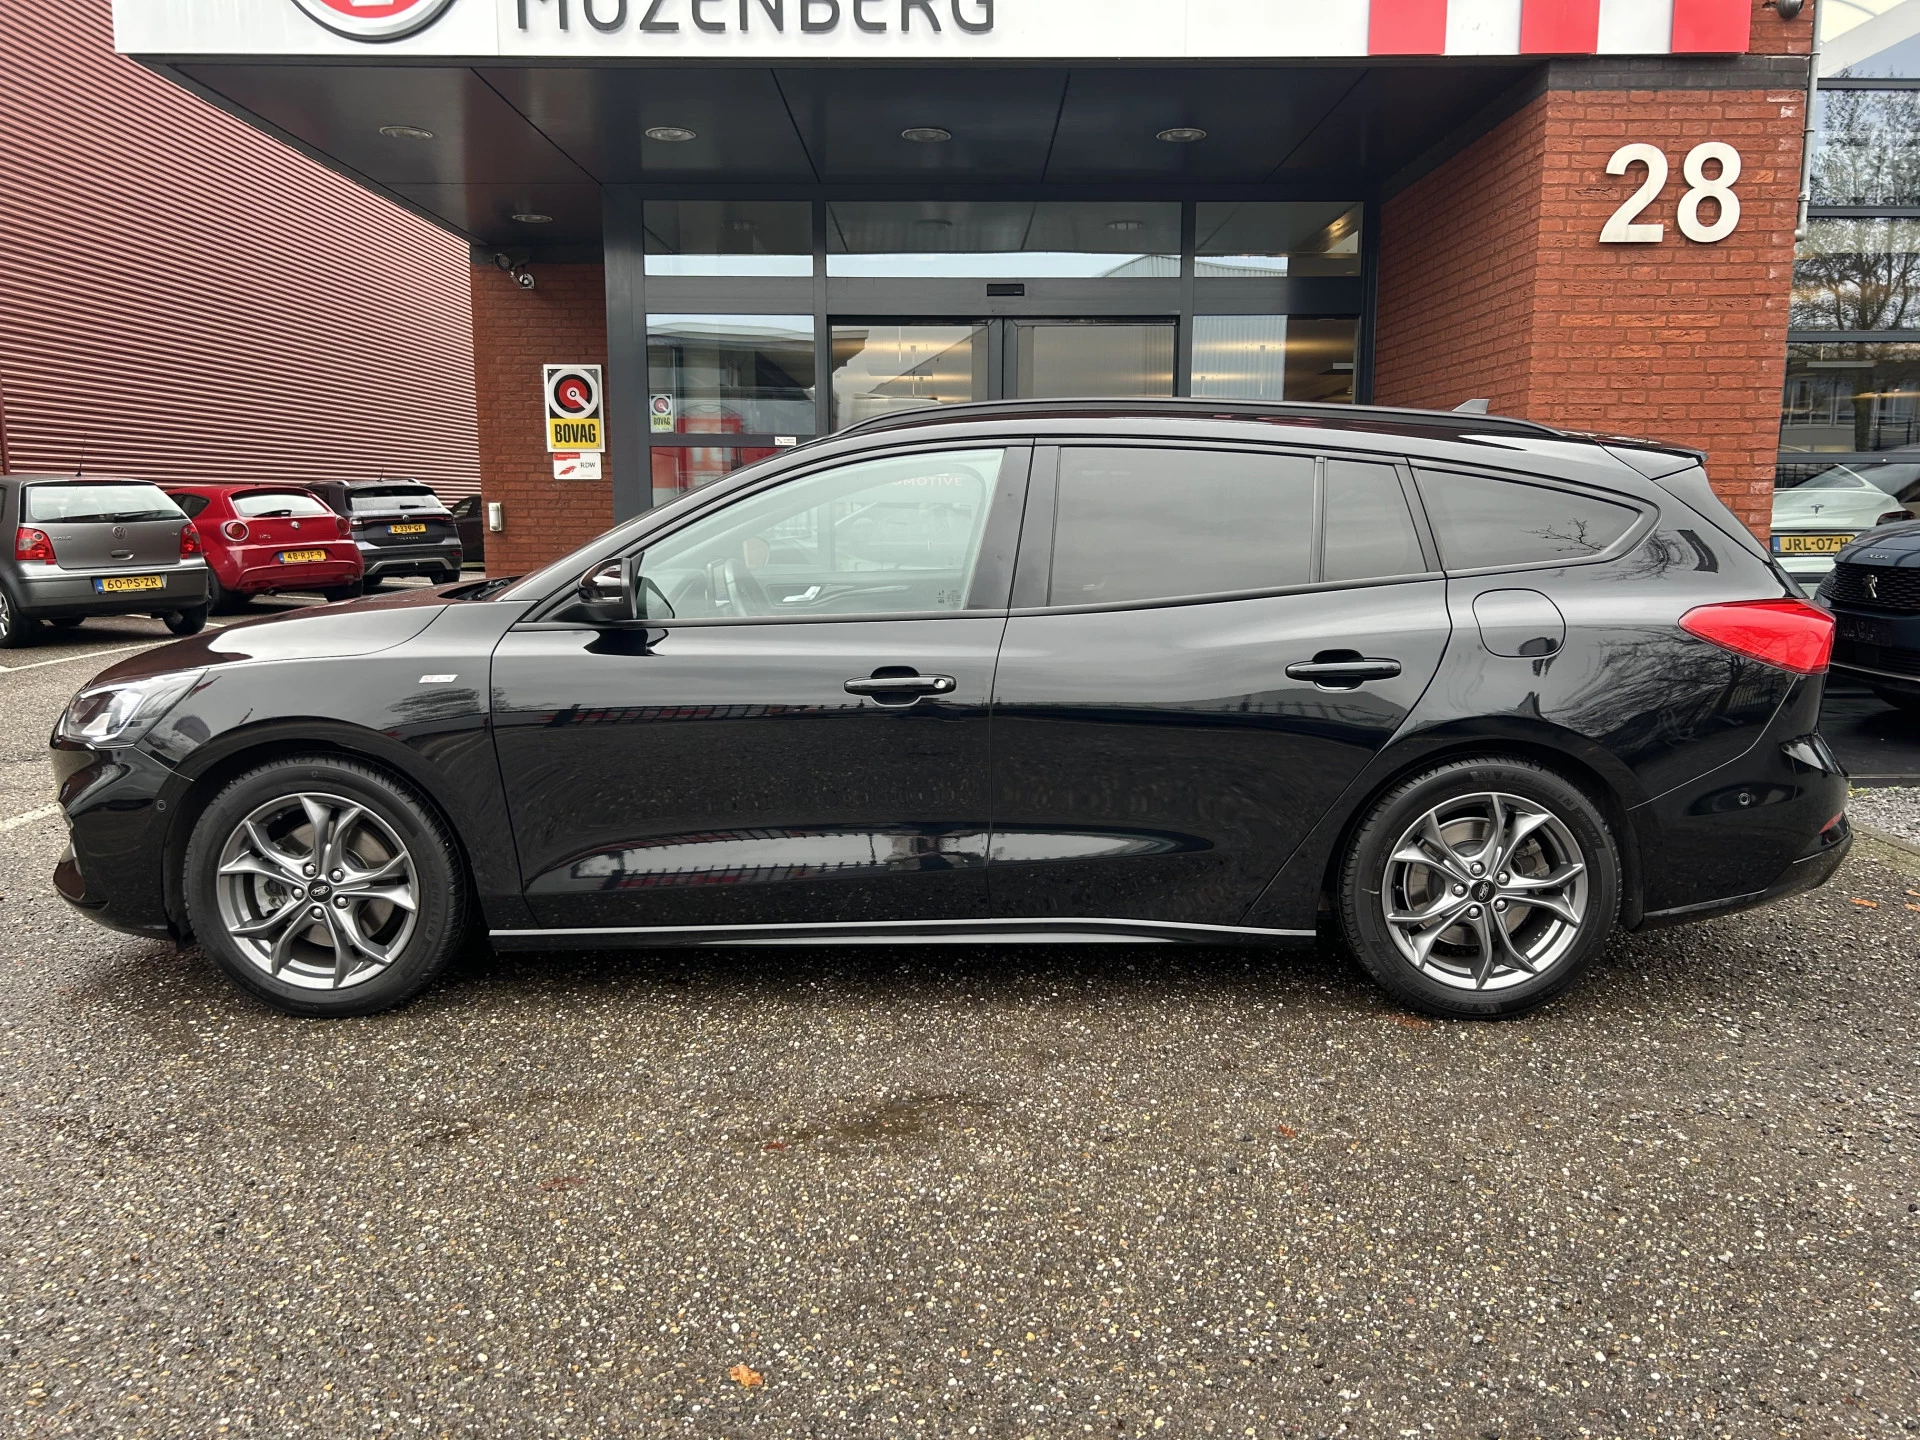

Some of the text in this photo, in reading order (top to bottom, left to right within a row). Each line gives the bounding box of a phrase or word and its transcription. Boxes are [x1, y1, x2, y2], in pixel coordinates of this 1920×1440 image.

[1599, 142, 1741, 243] 28
[653, 417, 671, 426] BOVAG
[554, 424, 597, 443] BOVAG
[1785, 538, 1848, 551] JRL-07-H
[287, 551, 322, 560] 48-RJF-9
[107, 576, 158, 590] 60-PS-ZR
